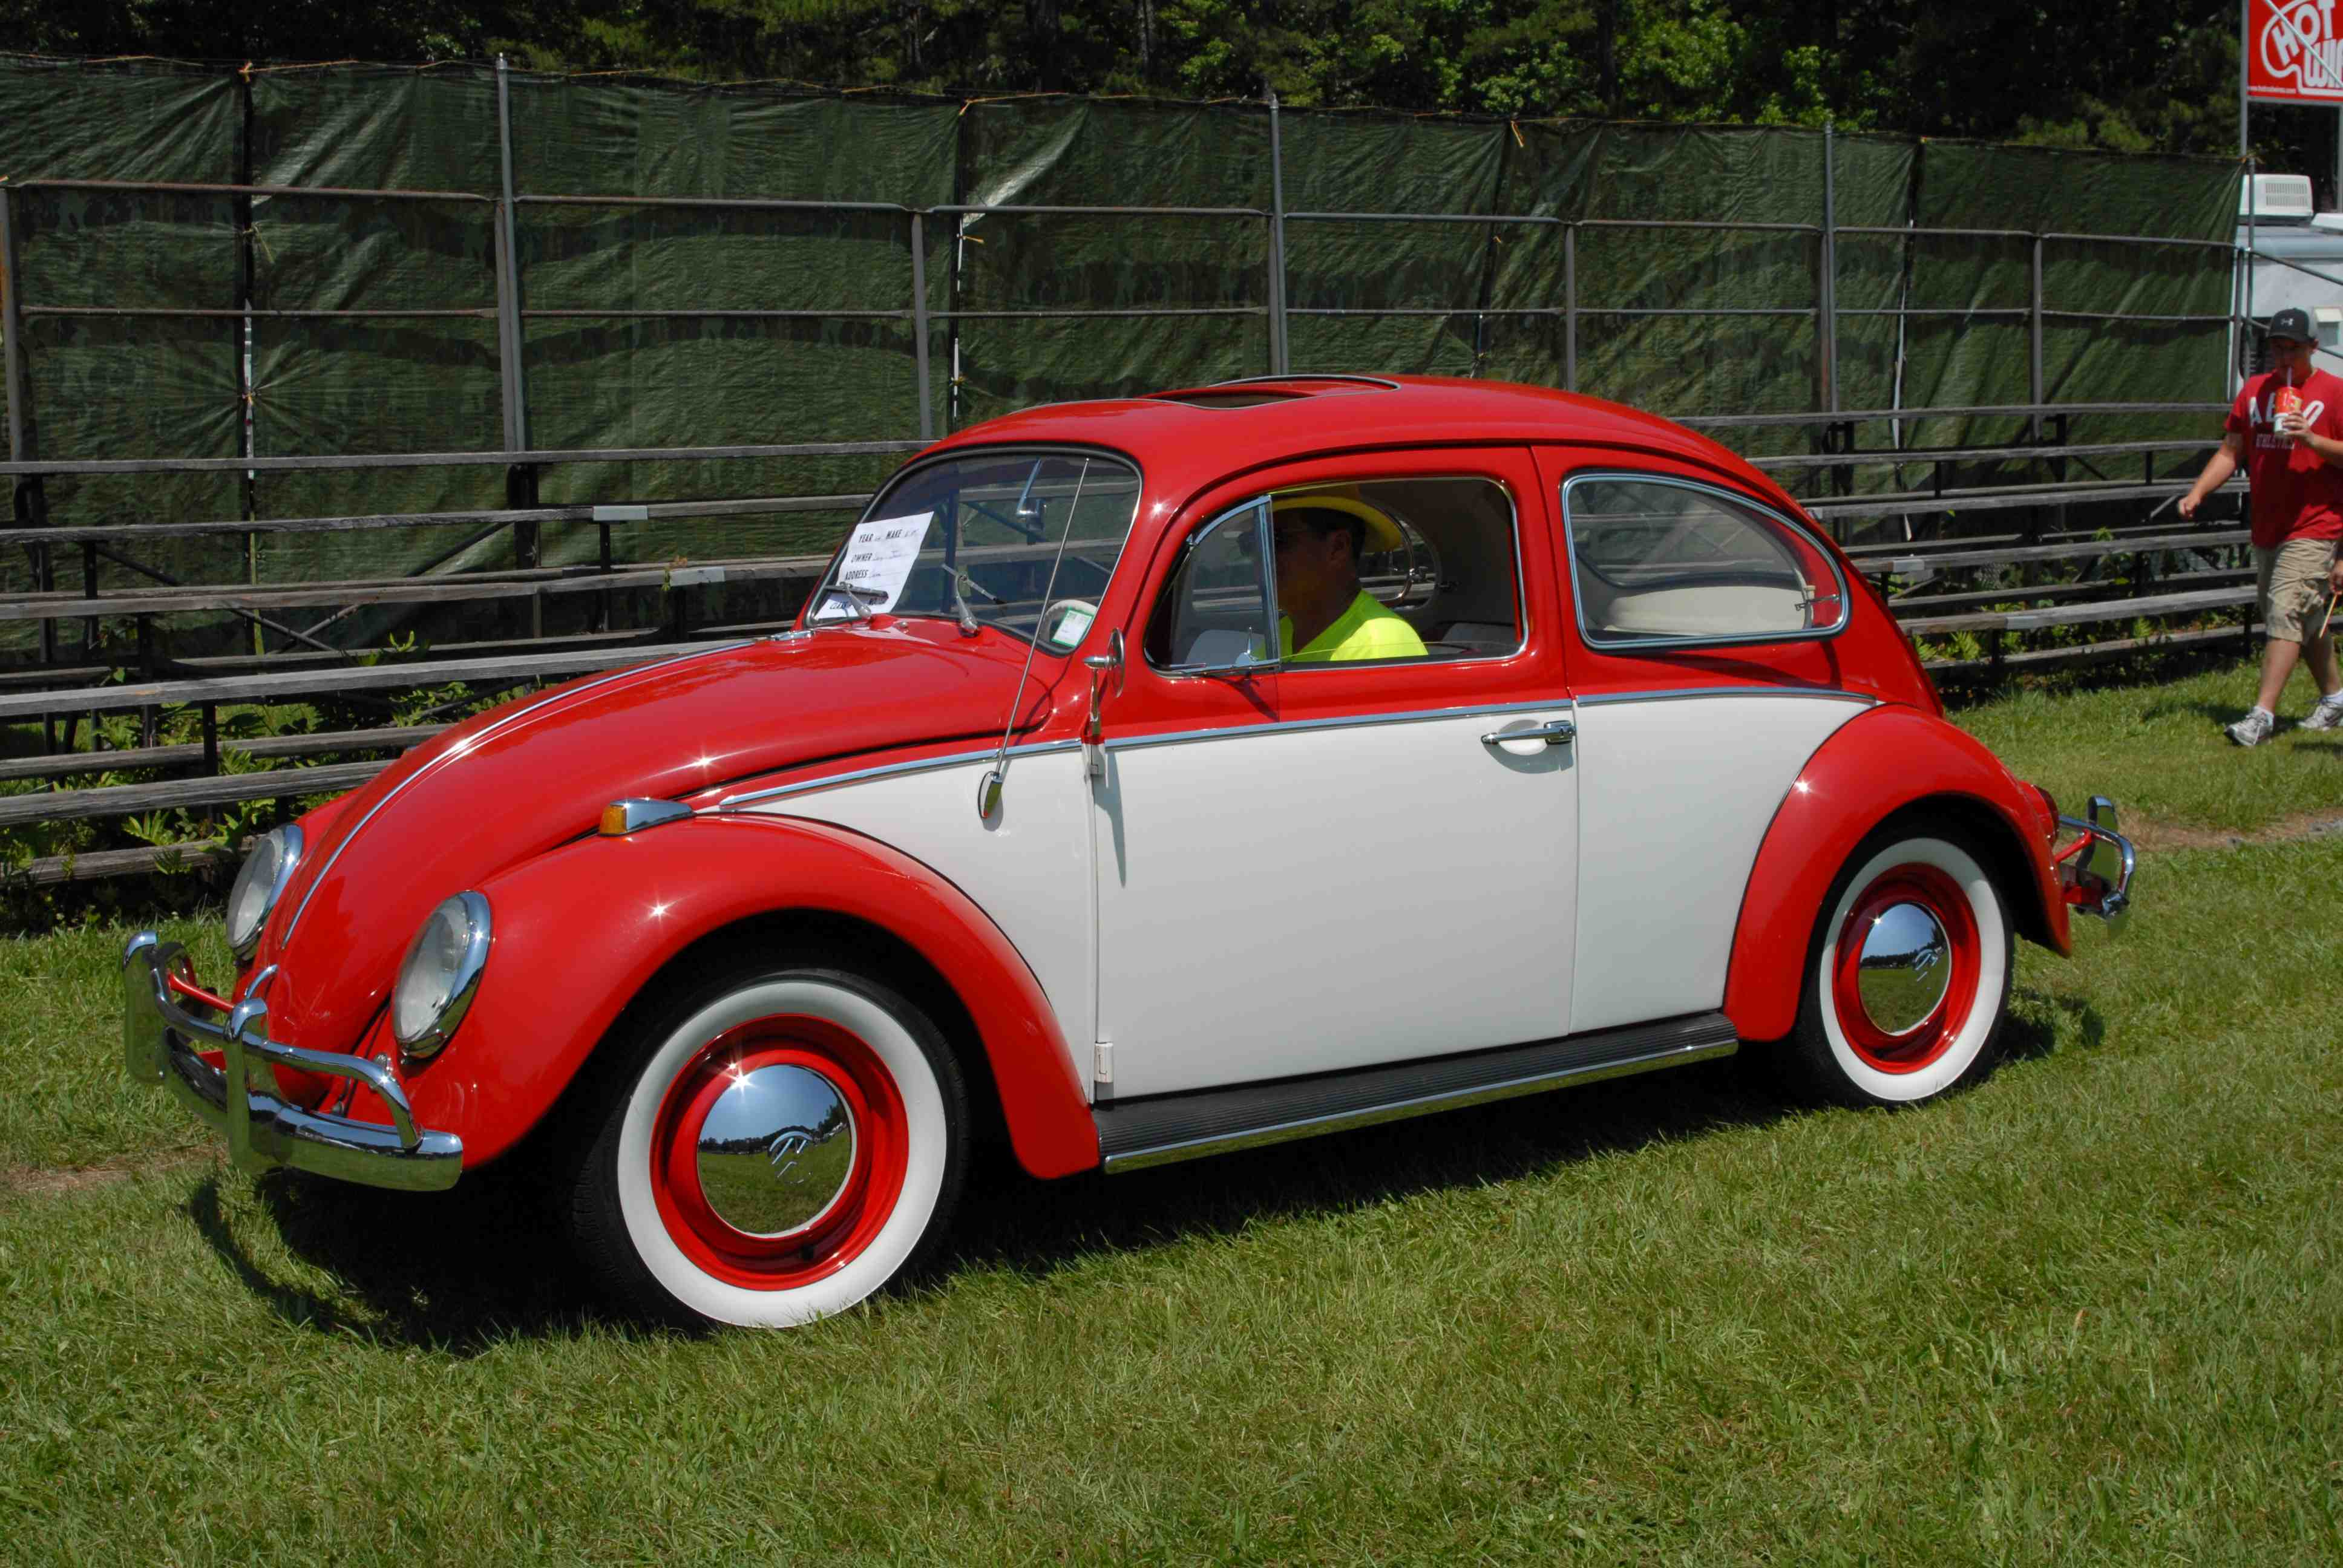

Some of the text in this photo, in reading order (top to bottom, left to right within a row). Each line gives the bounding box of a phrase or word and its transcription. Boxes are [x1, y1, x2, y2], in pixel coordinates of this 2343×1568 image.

[2272, 0, 2335, 67] HOT
[858, 534, 874, 543] YEAR
[885, 529, 902, 540] MAKE
[851, 553, 873, 563] OWNER
[844, 569, 869, 580] ADDRESS
